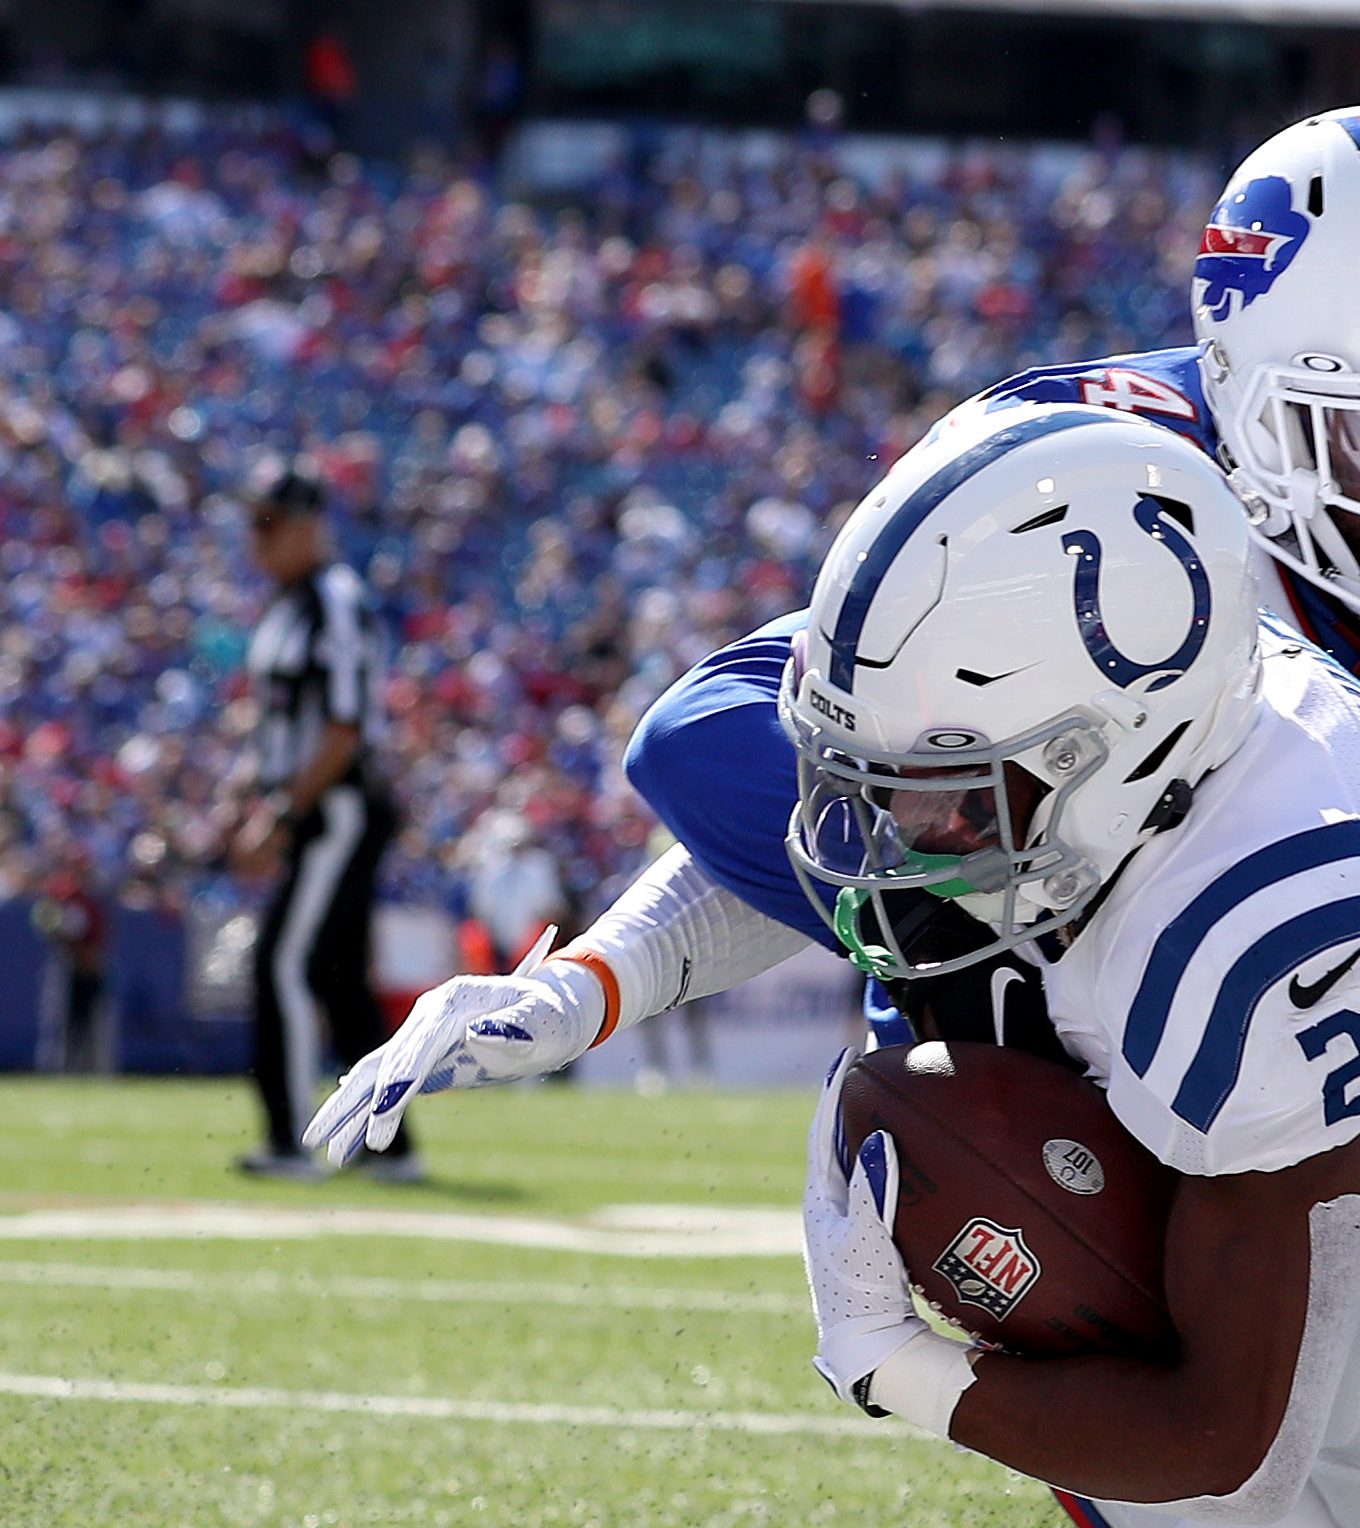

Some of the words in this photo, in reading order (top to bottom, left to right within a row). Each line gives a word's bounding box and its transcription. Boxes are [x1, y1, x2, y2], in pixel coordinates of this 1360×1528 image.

[810, 689, 856, 731] COLTS
[1062, 1146, 1094, 1176] 107
[963, 1227, 1031, 1294] NFL
